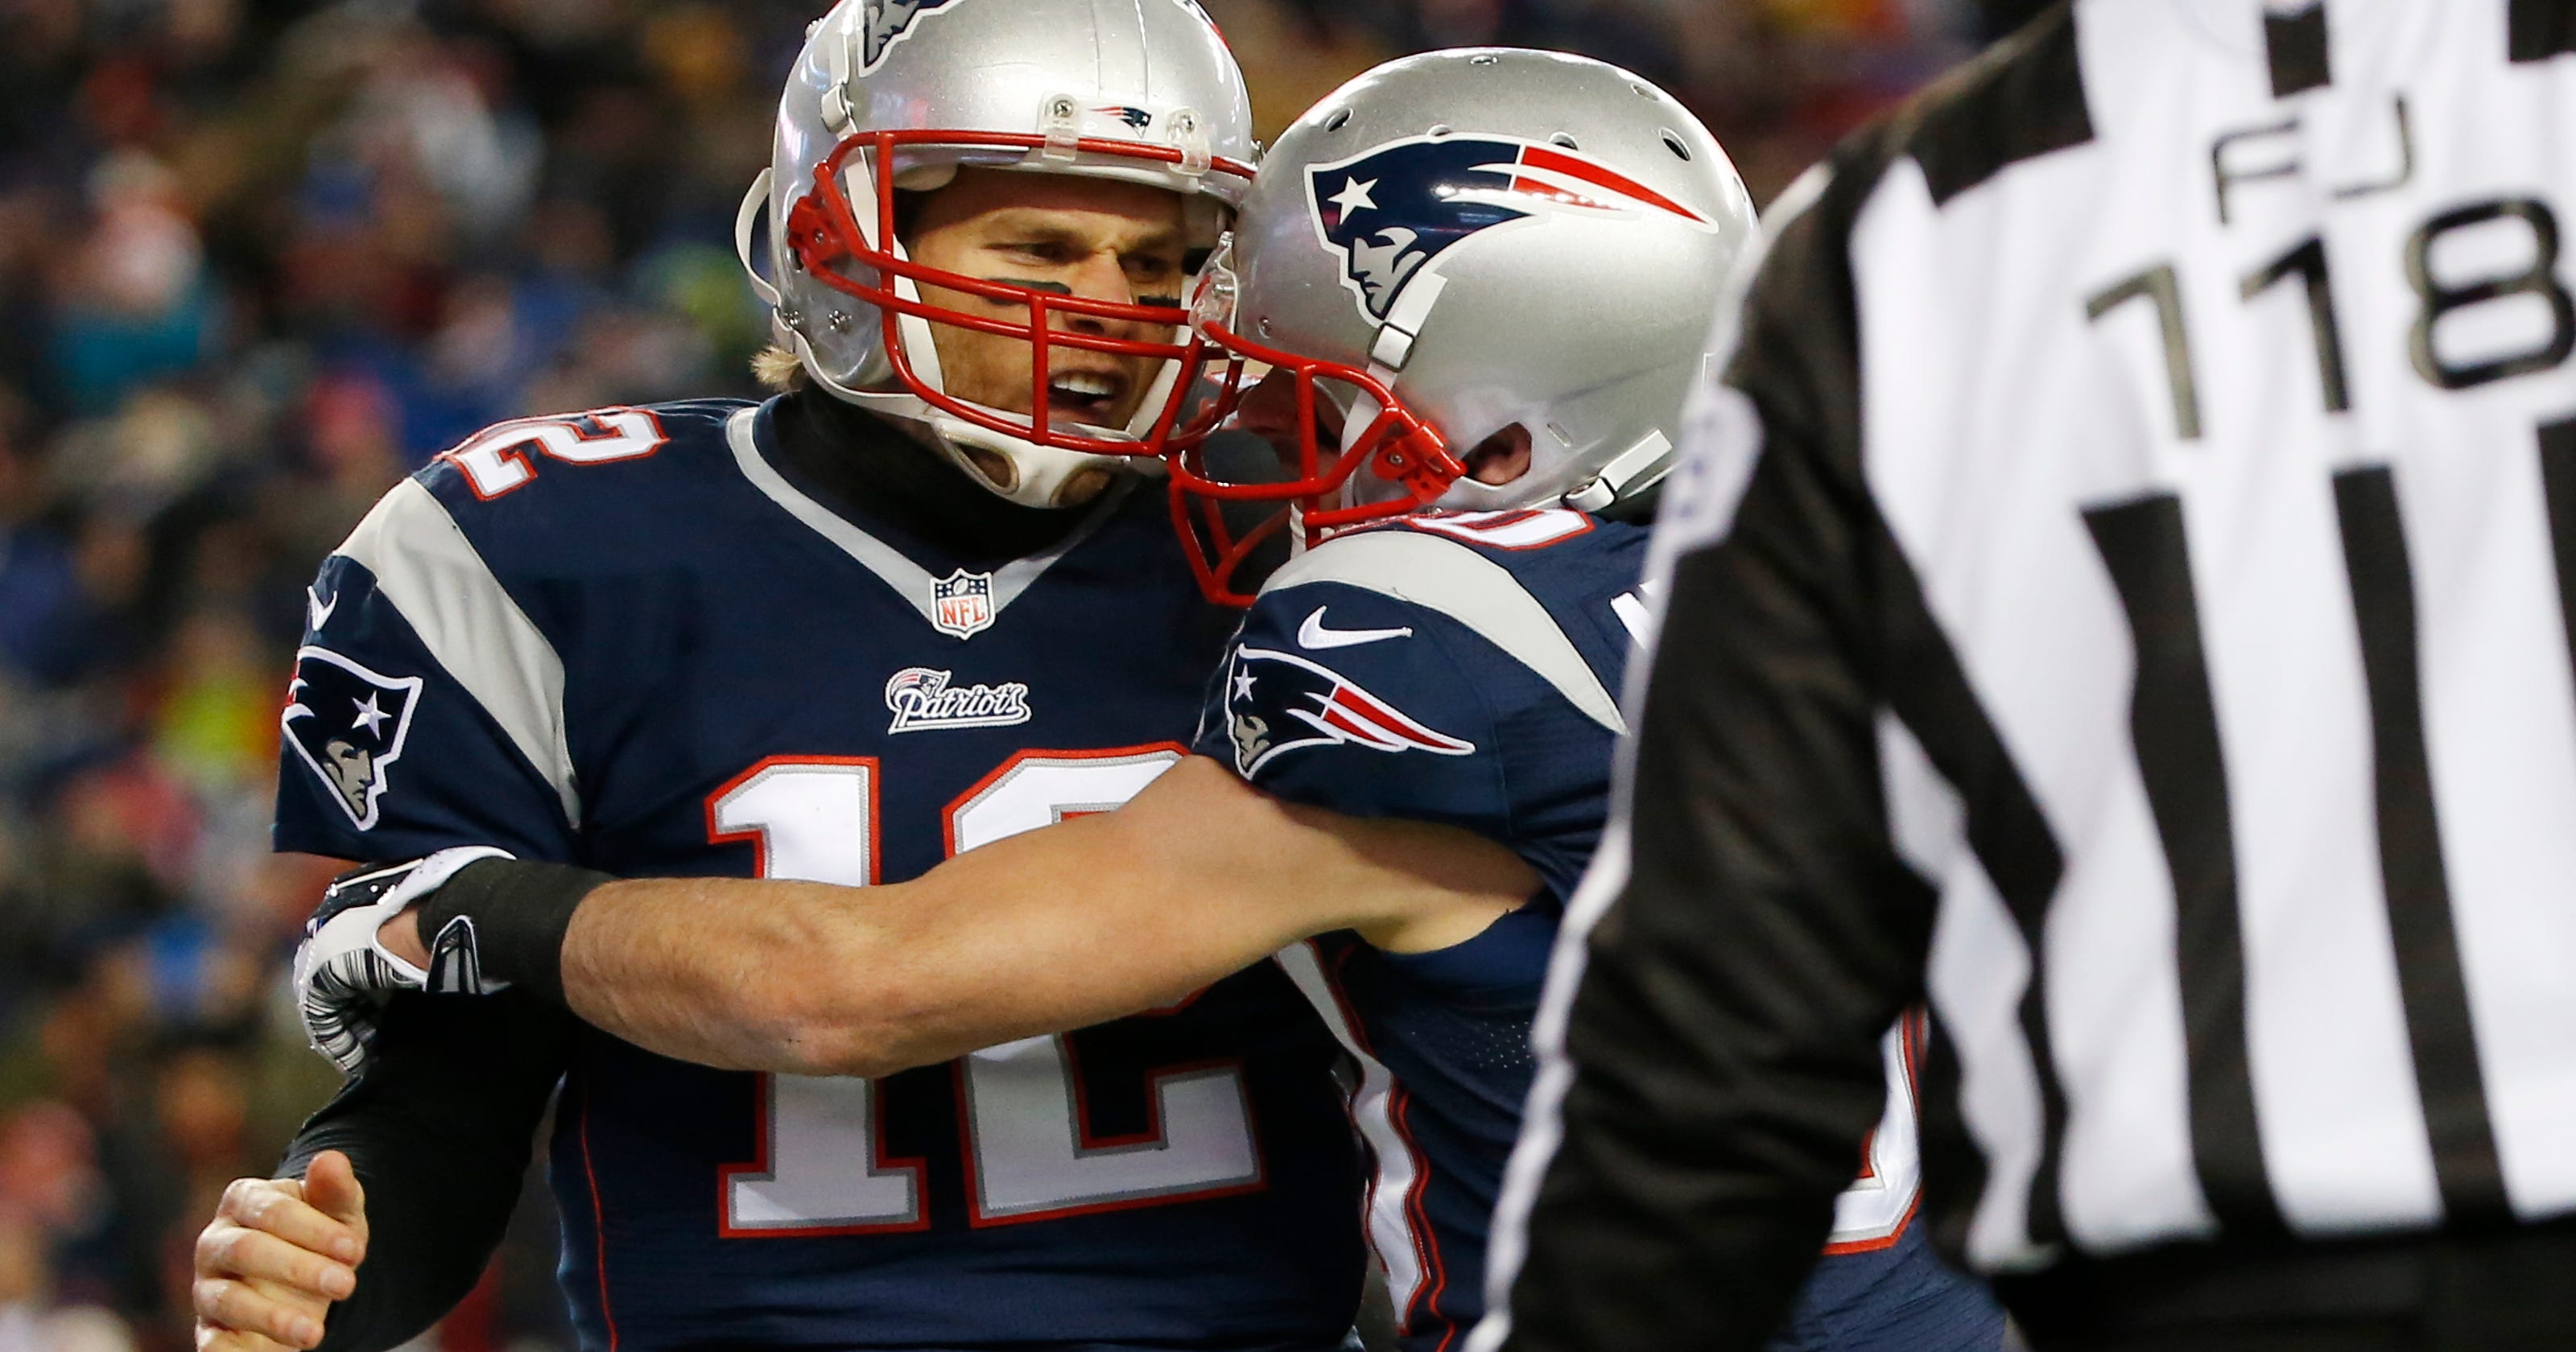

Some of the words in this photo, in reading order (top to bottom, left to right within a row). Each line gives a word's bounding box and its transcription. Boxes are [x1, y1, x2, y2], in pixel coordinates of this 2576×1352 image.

[2211, 91, 2415, 228] FJ
[2085, 195, 2575, 443] 118
[941, 597, 985, 627] NFL
[887, 678, 1030, 732] Patriots
